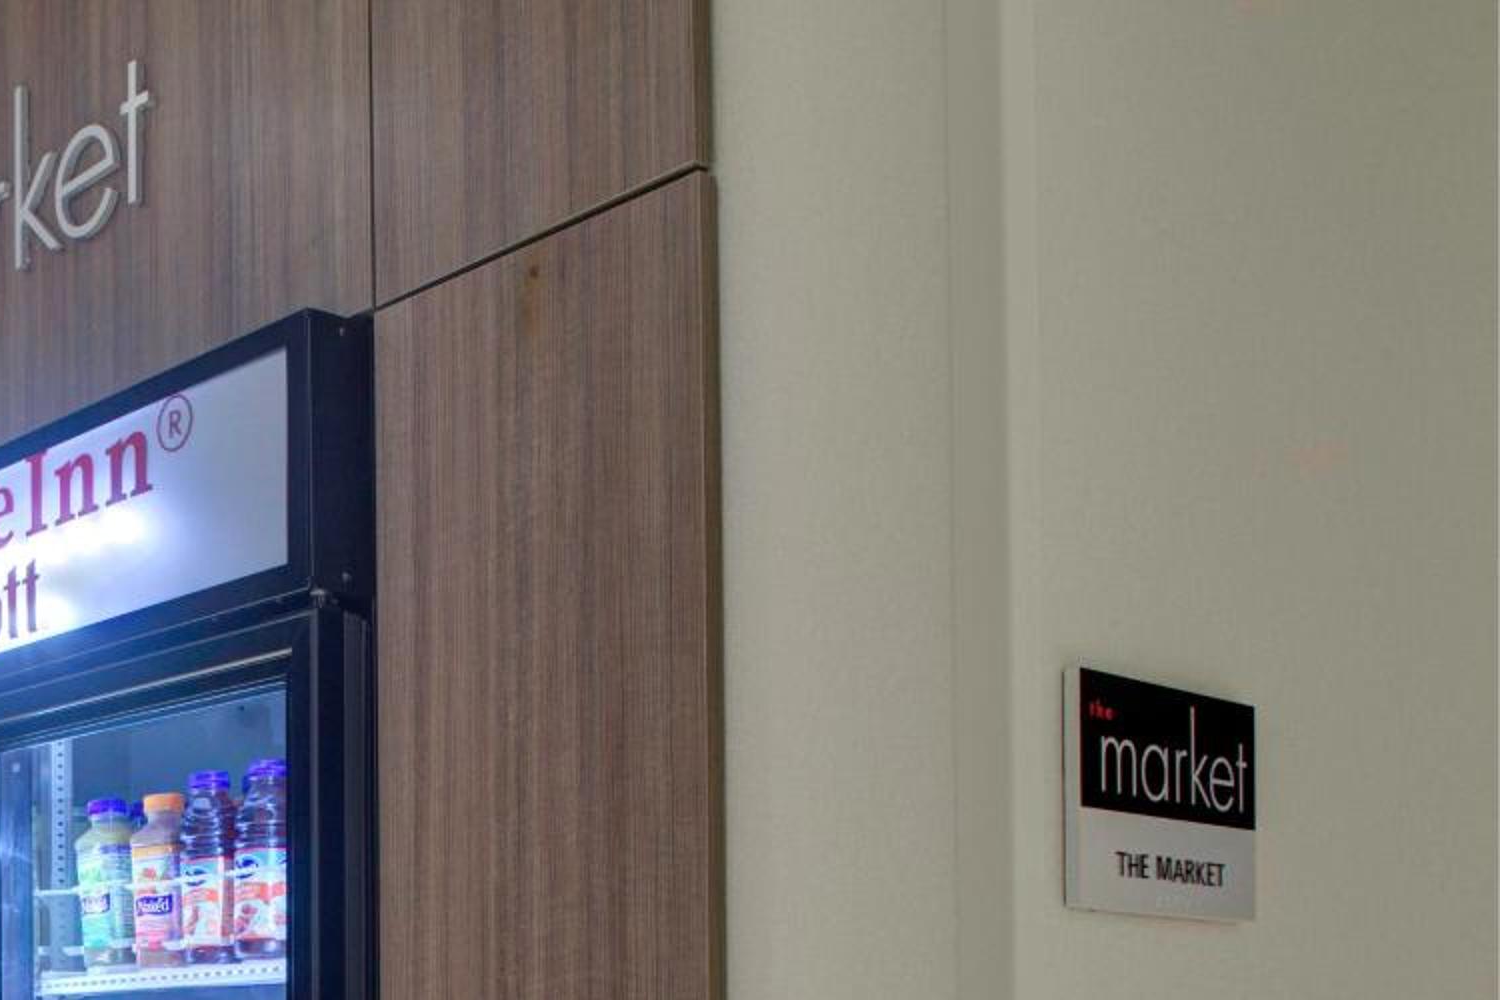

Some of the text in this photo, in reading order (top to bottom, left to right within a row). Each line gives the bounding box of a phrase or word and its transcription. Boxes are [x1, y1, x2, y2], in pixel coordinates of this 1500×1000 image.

[1101, 704, 1247, 814] market
[1115, 851, 1226, 888] THE MARKET
